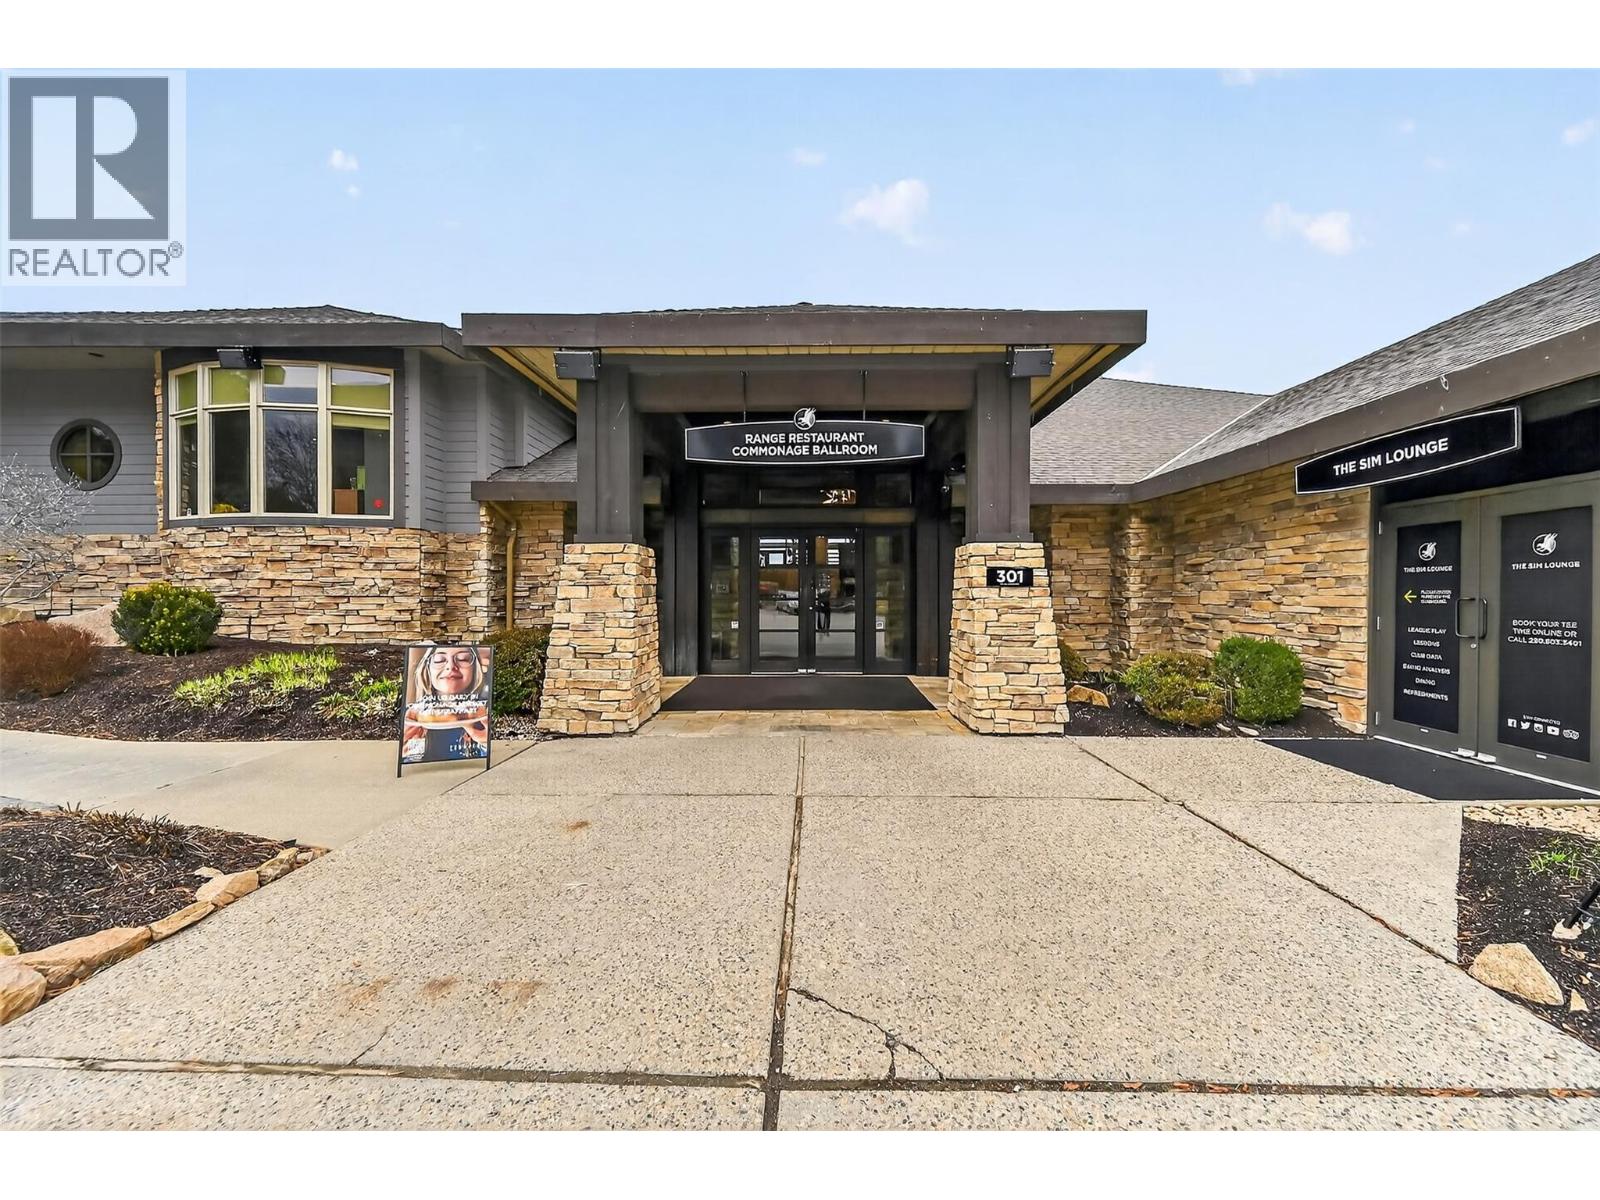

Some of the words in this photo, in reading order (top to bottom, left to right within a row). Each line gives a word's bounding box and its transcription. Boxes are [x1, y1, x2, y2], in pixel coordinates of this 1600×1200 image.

[745, 433, 786, 444] RANGE
[788, 432, 865, 444] RESTAURANT
[732, 445, 810, 457] COMMONAGE
[812, 444, 878, 455] BALLROOM
[1333, 461, 1357, 476] THE
[1359, 454, 1382, 470] SIM
[1385, 437, 1449, 464] LOUNGE
[1544, 561, 1581, 569] LOUNGE
[996, 570, 1024, 583] 301
[1512, 619, 1536, 627] BOOK
[1536, 620, 1560, 628] YOUR
[1561, 621, 1578, 629] TEE
[1512, 627, 1531, 635] TIME
[1531, 629, 1562, 637] ONLINE
[1563, 630, 1578, 638] OR
[1507, 636, 1528, 644] CALL
